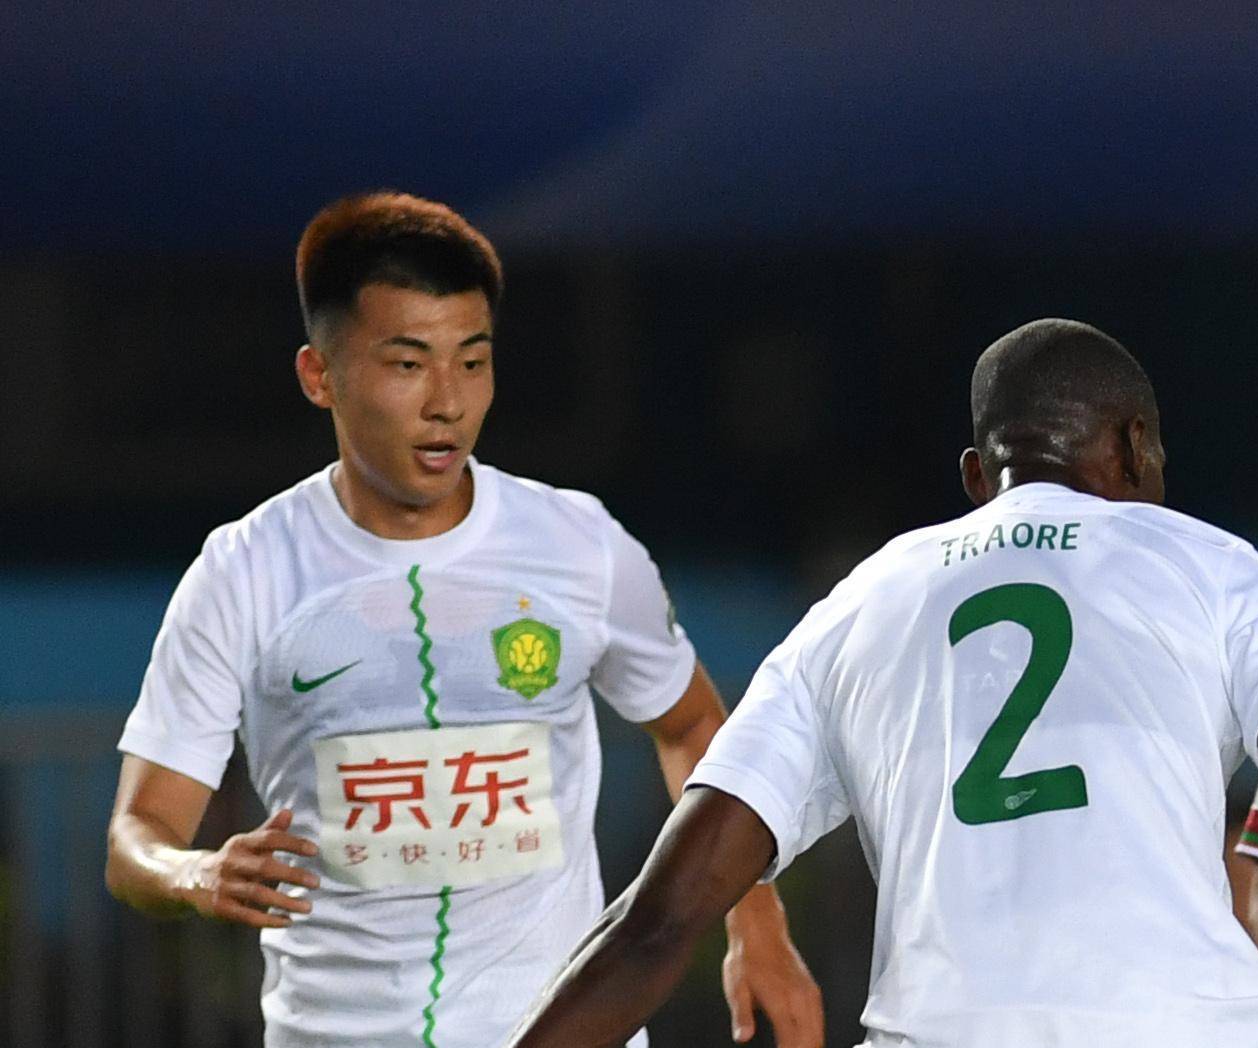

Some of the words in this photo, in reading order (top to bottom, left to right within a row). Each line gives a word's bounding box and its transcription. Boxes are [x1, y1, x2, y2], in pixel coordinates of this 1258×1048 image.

[941, 522, 1081, 566] TRAORE
[948, 582, 1089, 826] 2
[337, 747, 533, 833] 京东
